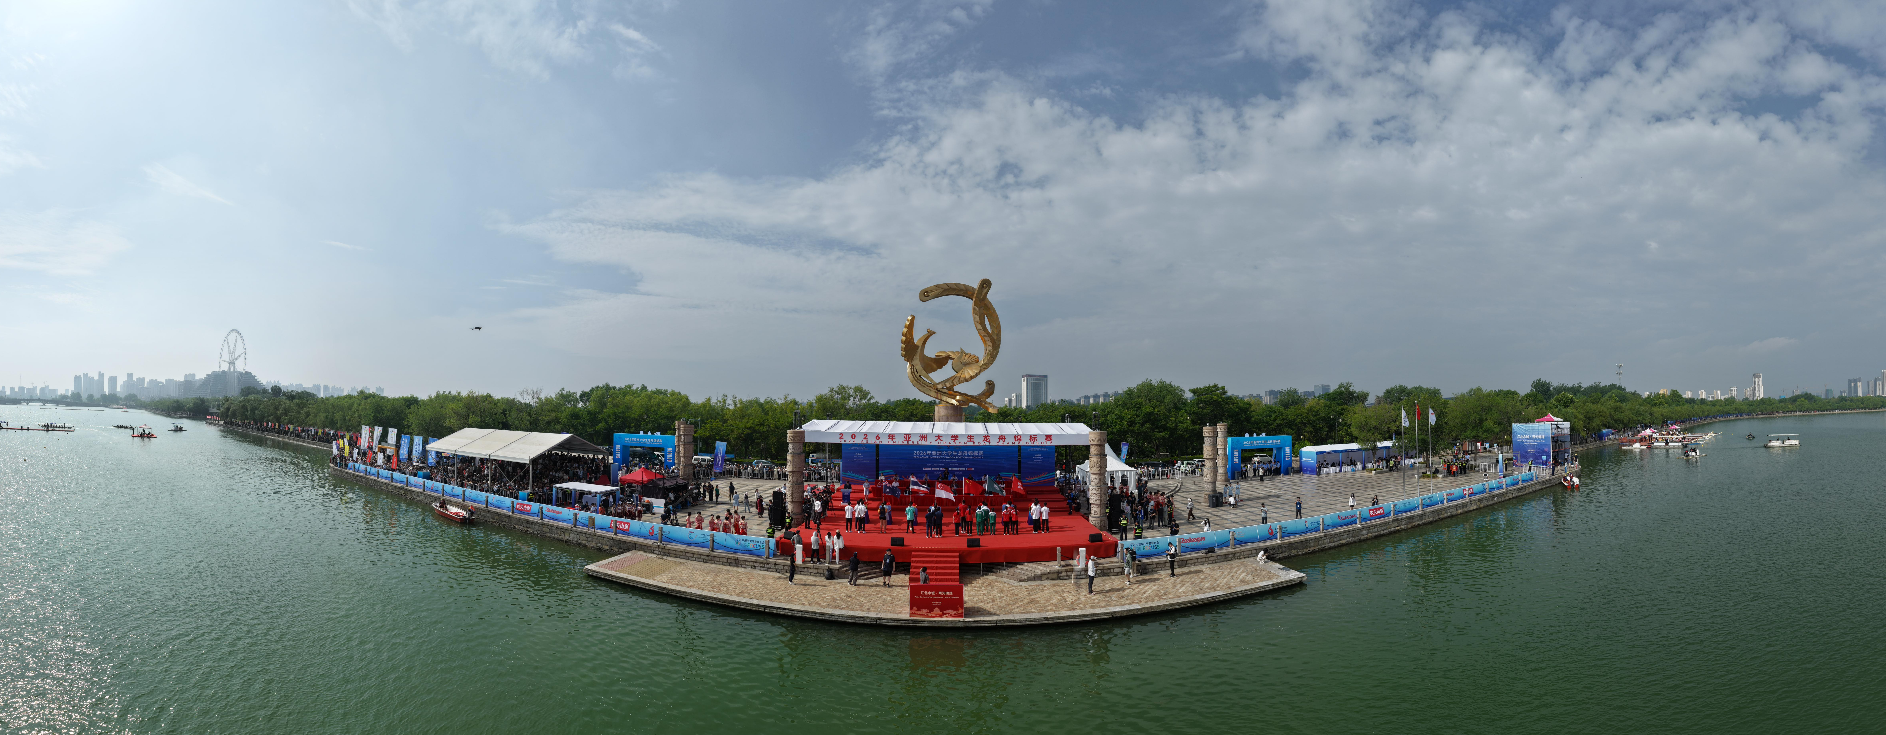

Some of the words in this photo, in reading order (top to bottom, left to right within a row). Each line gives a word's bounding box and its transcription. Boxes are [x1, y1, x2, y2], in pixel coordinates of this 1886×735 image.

[838, 433, 1053, 442] 2026年亚洲大学生龙舟锦标赛
